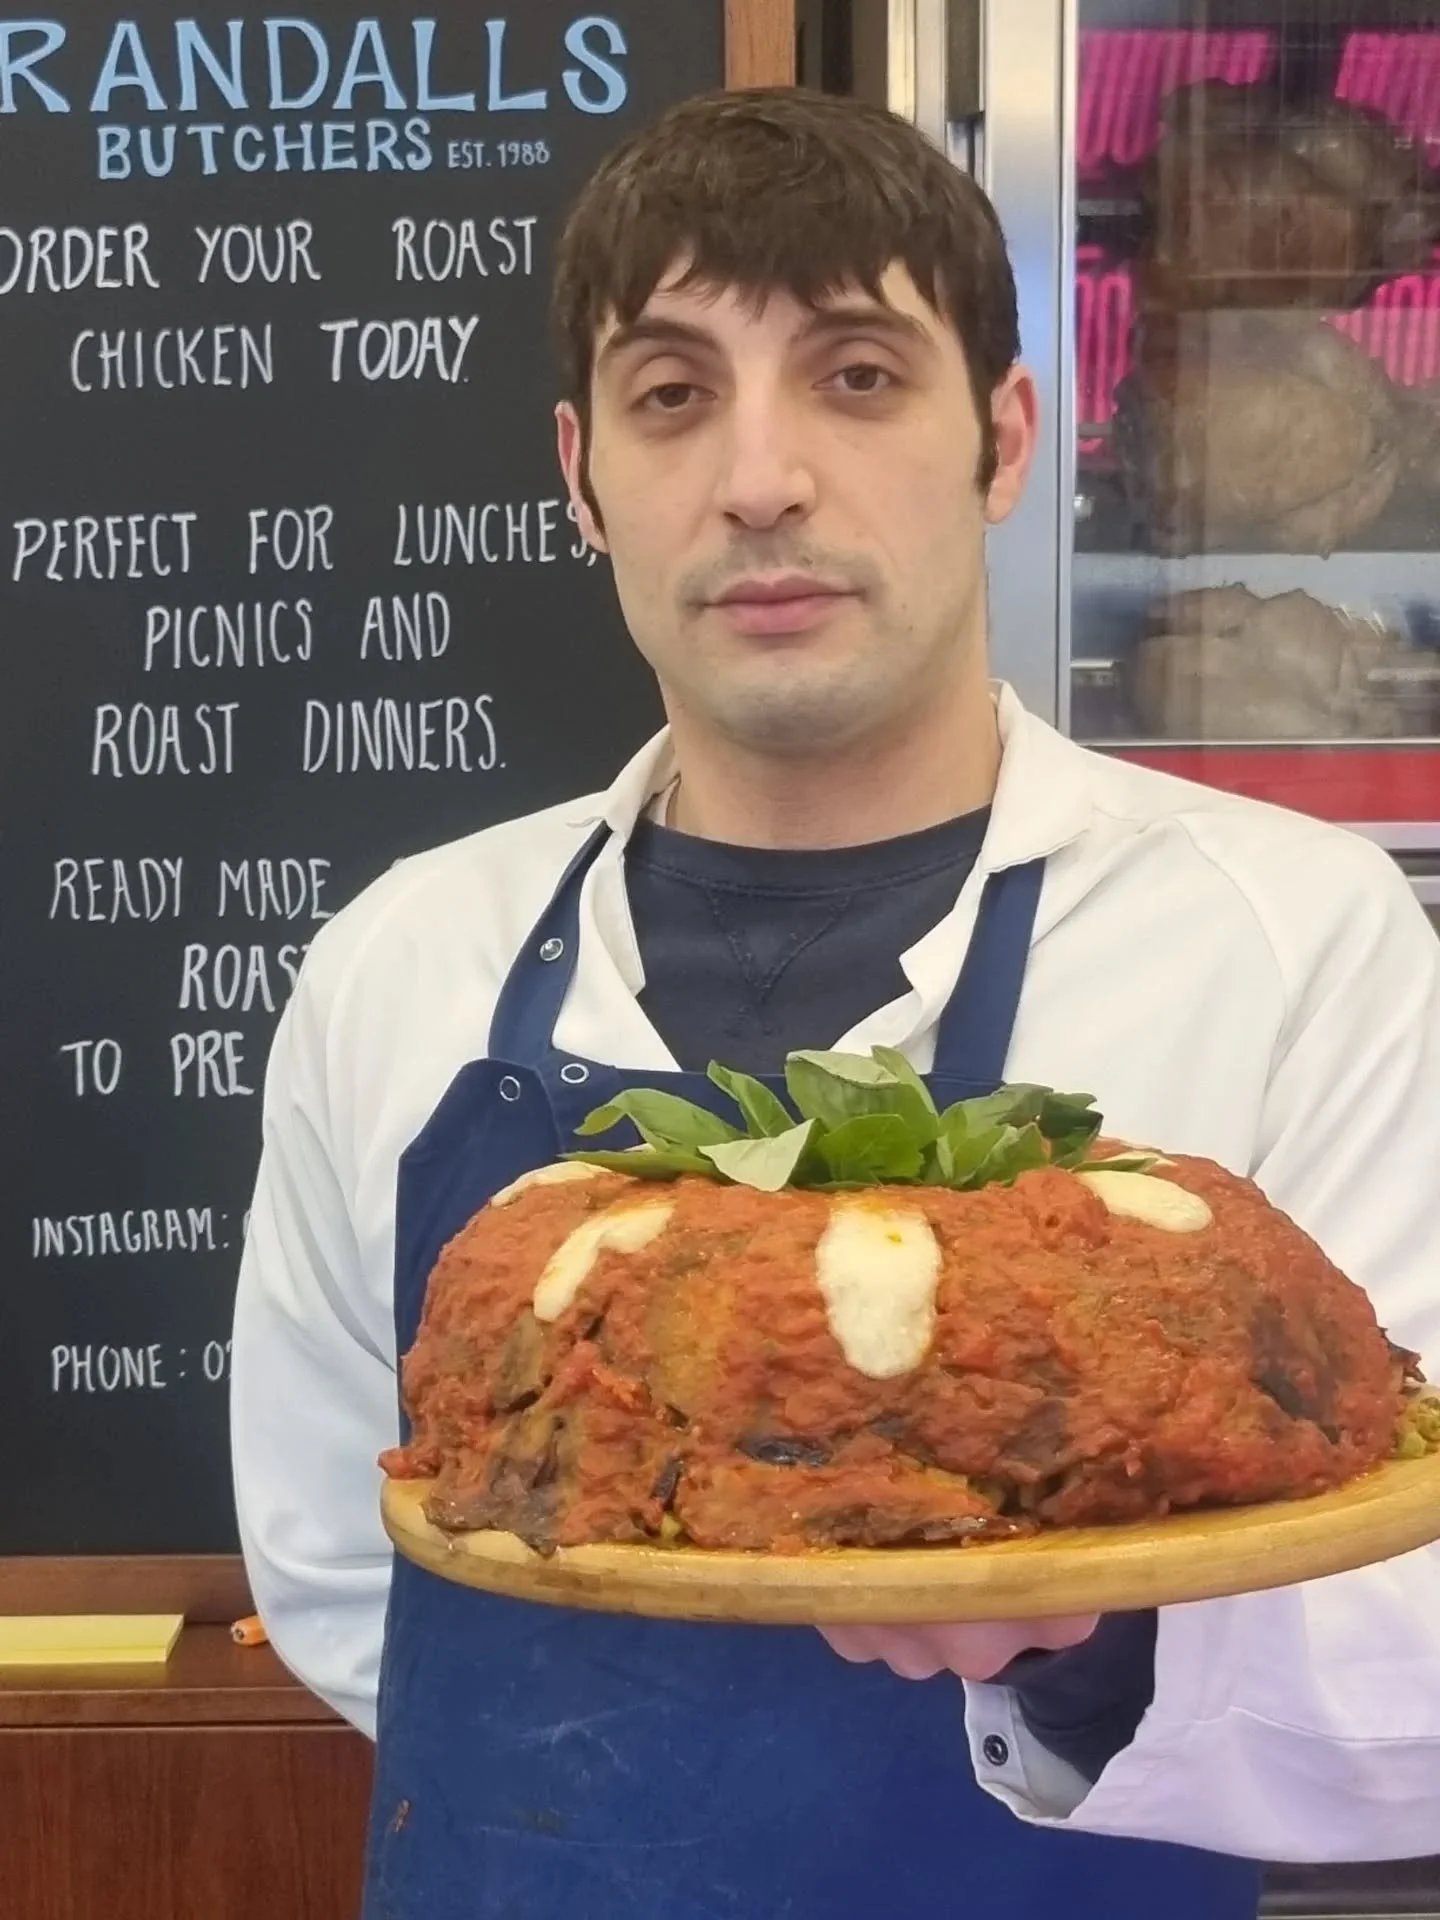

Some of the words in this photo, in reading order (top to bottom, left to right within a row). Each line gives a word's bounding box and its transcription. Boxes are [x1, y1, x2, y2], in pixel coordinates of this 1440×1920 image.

[0, 16, 627, 114] RANDALLS
[97, 118, 432, 180] BUTCHERS
[447, 141, 492, 168] EST.
[496, 139, 551, 168] 1988
[0, 221, 160, 294] ORDER
[196, 218, 321, 284] YOUR
[392, 215, 539, 283] ROAST
[70, 322, 274, 392] CHICKEN
[319, 315, 480, 384] TODAY.
[12, 512, 198, 582] PERFECT
[248, 504, 334, 574] FOR
[144, 599, 313, 671] PICNICS
[360, 592, 451, 660] AND
[91, 702, 240, 778] ROAST
[302, 695, 507, 774] DINNERS.
[50, 857, 183, 923] READY
[218, 858, 335, 921] MADE
[178, 943, 312, 1012] ROAS
[60, 1038, 122, 1097] TO
[170, 1029, 254, 1098] PRE
[33, 1207, 230, 1258] INSTAGRAM:
